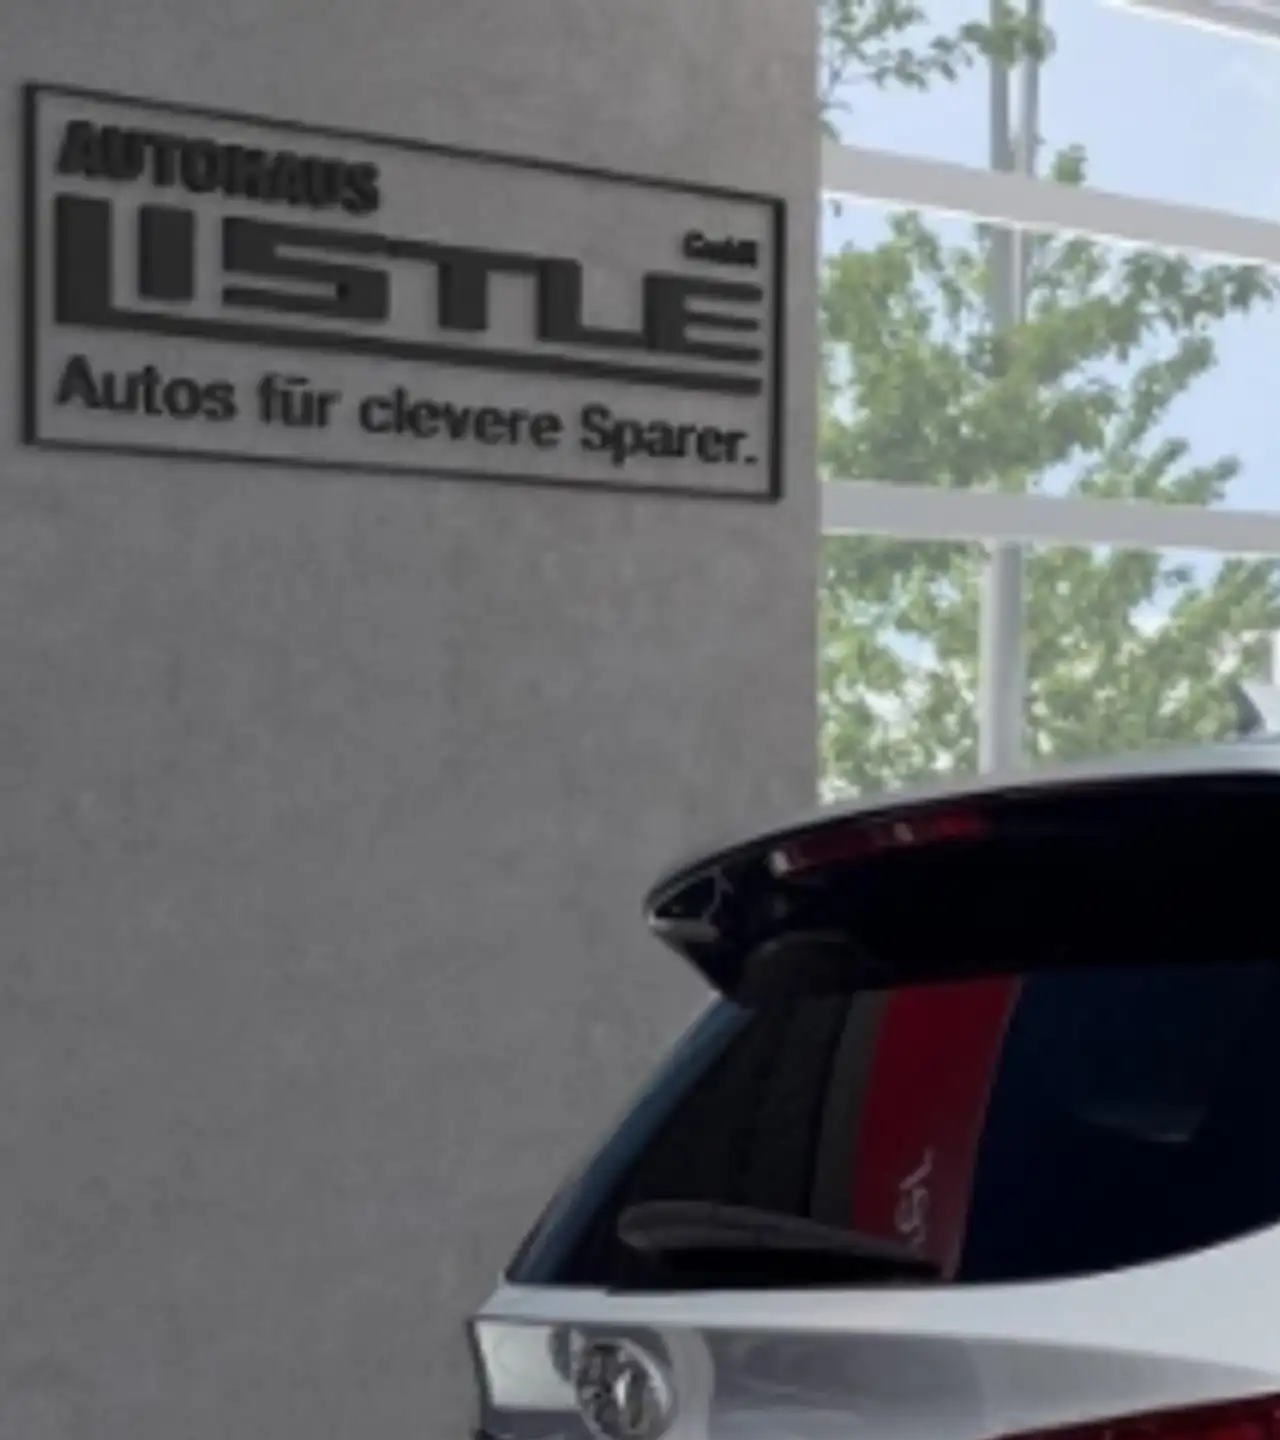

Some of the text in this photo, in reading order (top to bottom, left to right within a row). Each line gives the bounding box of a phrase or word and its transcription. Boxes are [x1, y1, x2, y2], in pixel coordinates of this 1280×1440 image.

[57, 121, 381, 214] AUTOHAUS
[54, 193, 764, 396] LISTLE
[57, 354, 760, 468] Autos für clevere Sparer.
